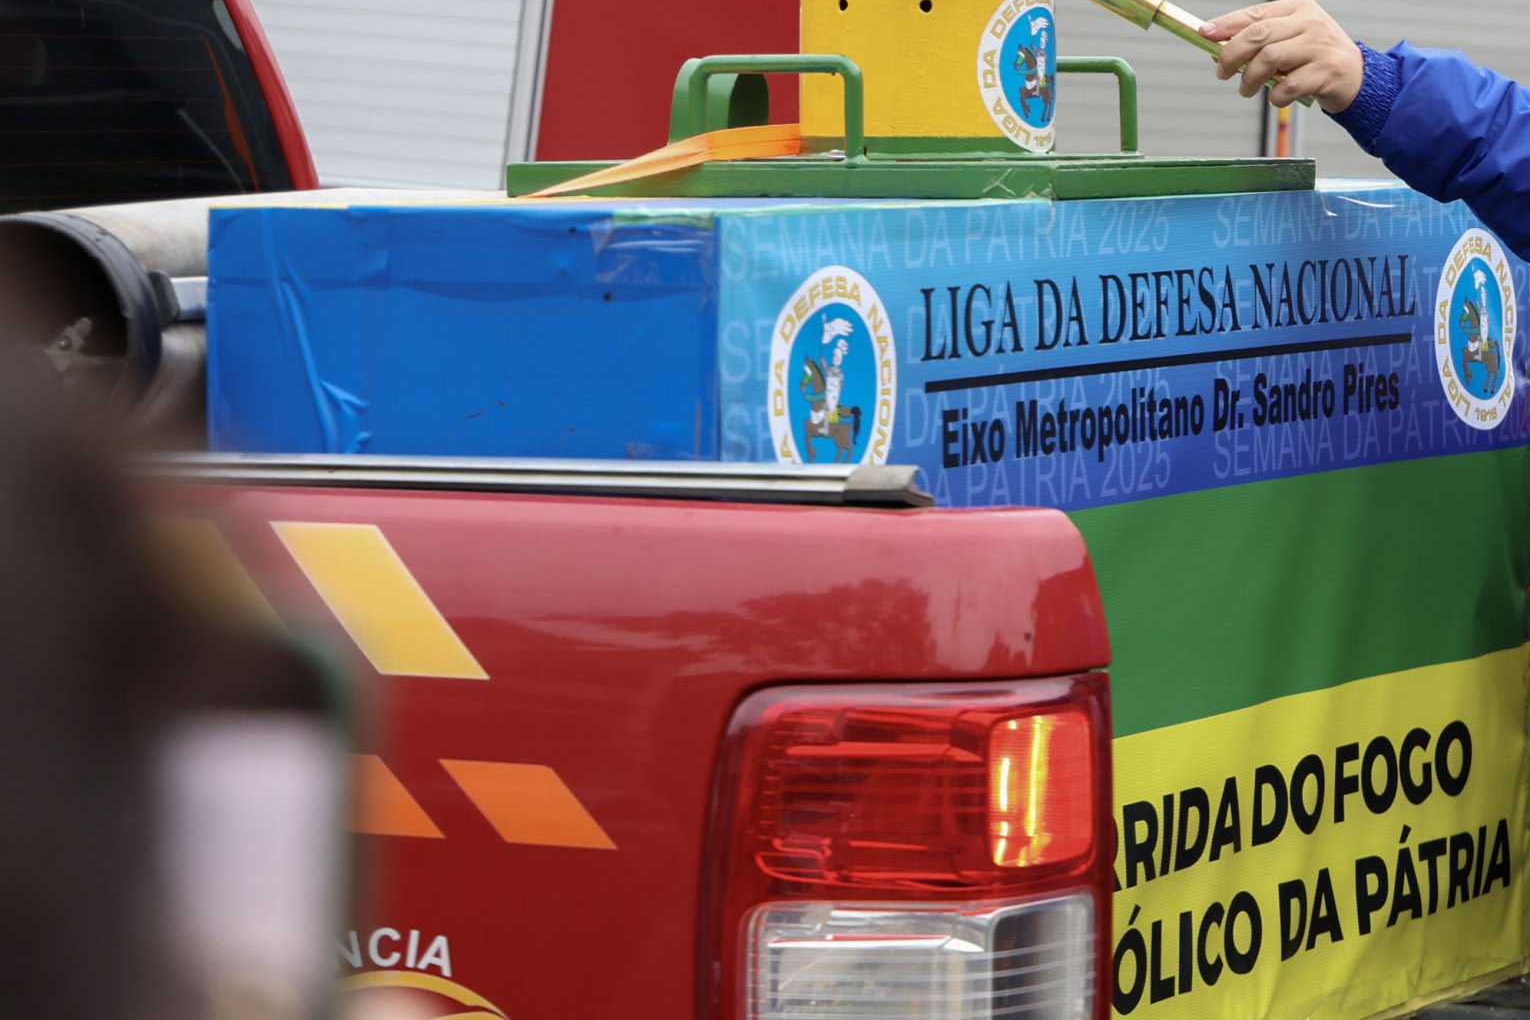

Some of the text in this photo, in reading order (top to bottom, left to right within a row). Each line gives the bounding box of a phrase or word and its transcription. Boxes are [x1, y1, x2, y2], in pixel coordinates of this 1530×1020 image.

[780, 276, 862, 345] DEFESA
[920, 280, 1024, 362] LIGA
[1034, 276, 1090, 351] DA
[1098, 264, 1242, 346] DEFESA
[1249, 253, 1418, 331] NACIONAL
[1444, 236, 1492, 288] DEFESA
[942, 362, 1400, 469] Eixo Metropolitano Dr. Sandro Pires
[1252, 754, 1325, 847] DO
[1334, 720, 1473, 824] FOGO
[334, 926, 453, 978] NCIA
[1112, 818, 1512, 1016] ÓLICO DA PÁTRIA
